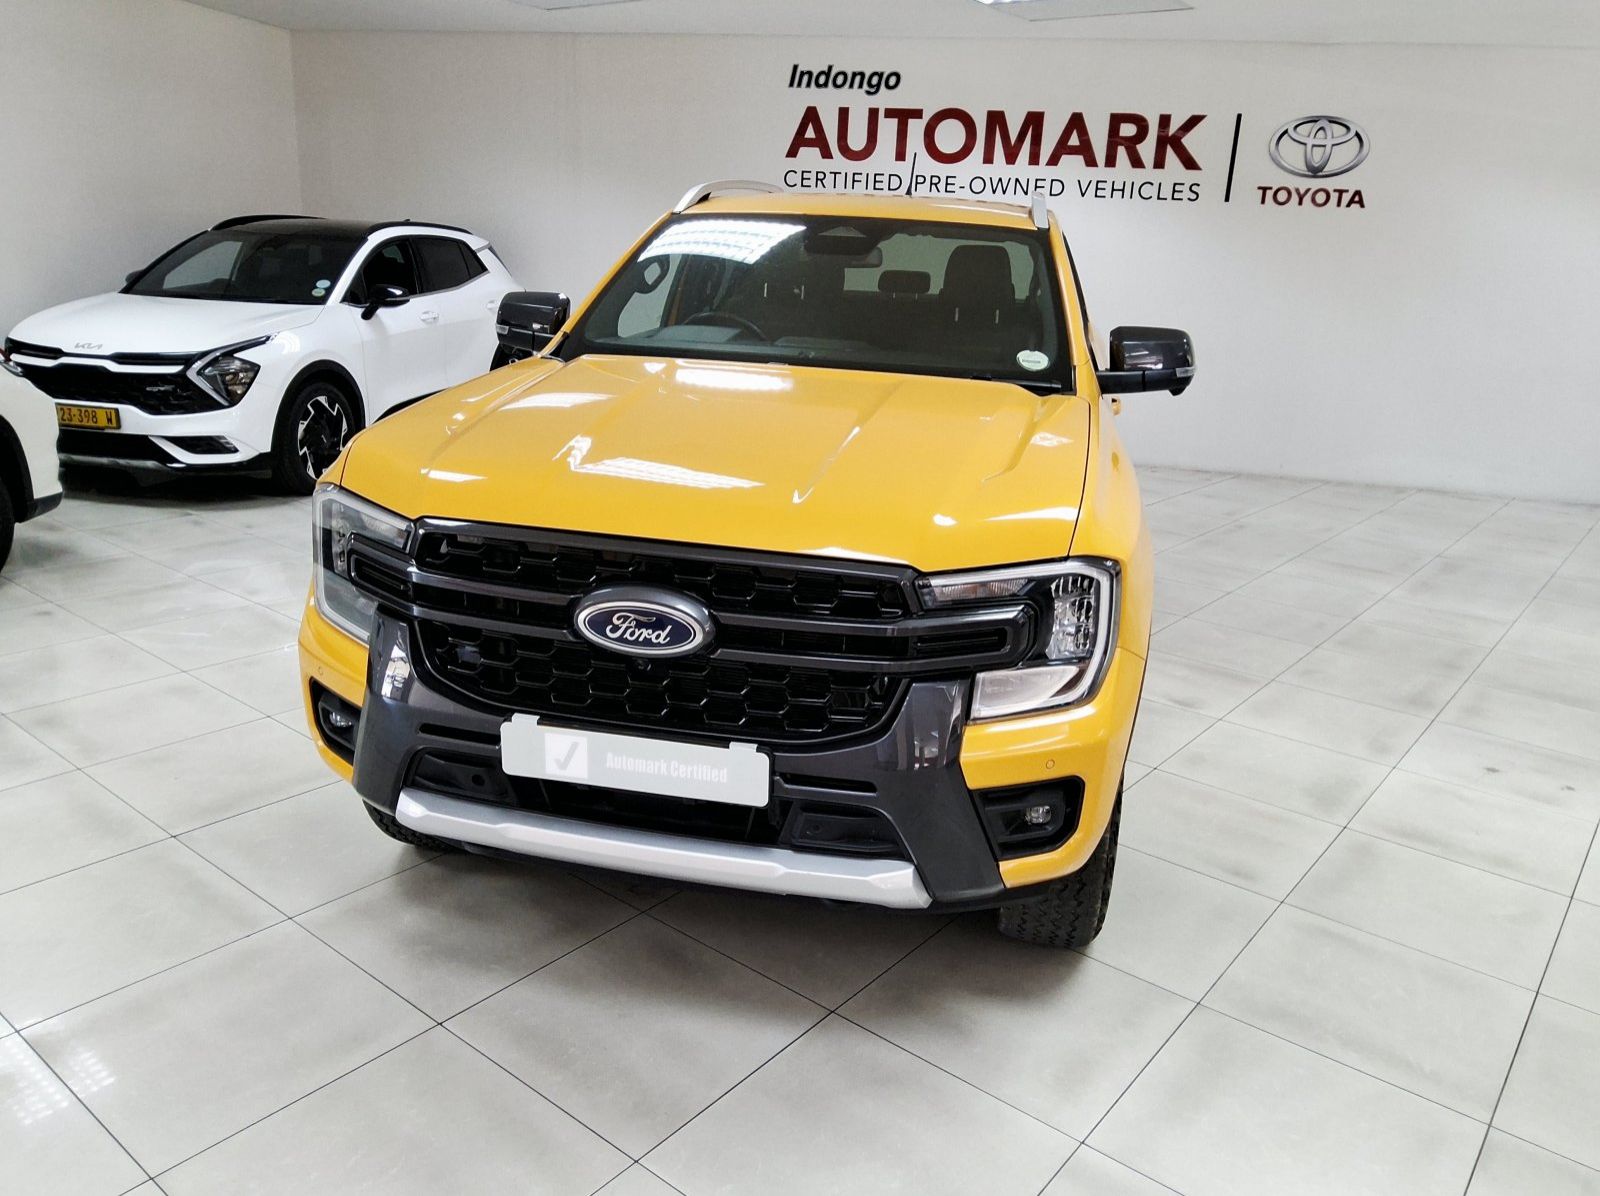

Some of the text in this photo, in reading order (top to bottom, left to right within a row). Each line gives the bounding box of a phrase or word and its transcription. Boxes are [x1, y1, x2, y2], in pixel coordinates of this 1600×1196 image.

[788, 64, 901, 95] Indongo
[785, 106, 1207, 171] AUTOMARK
[784, 170, 1201, 202] CERTIFIED PRE-OWNED VEHICLES
[1257, 186, 1365, 209] TOYOTA
[606, 612, 672, 644] Ford
[606, 752, 728, 783] Automark Certified
